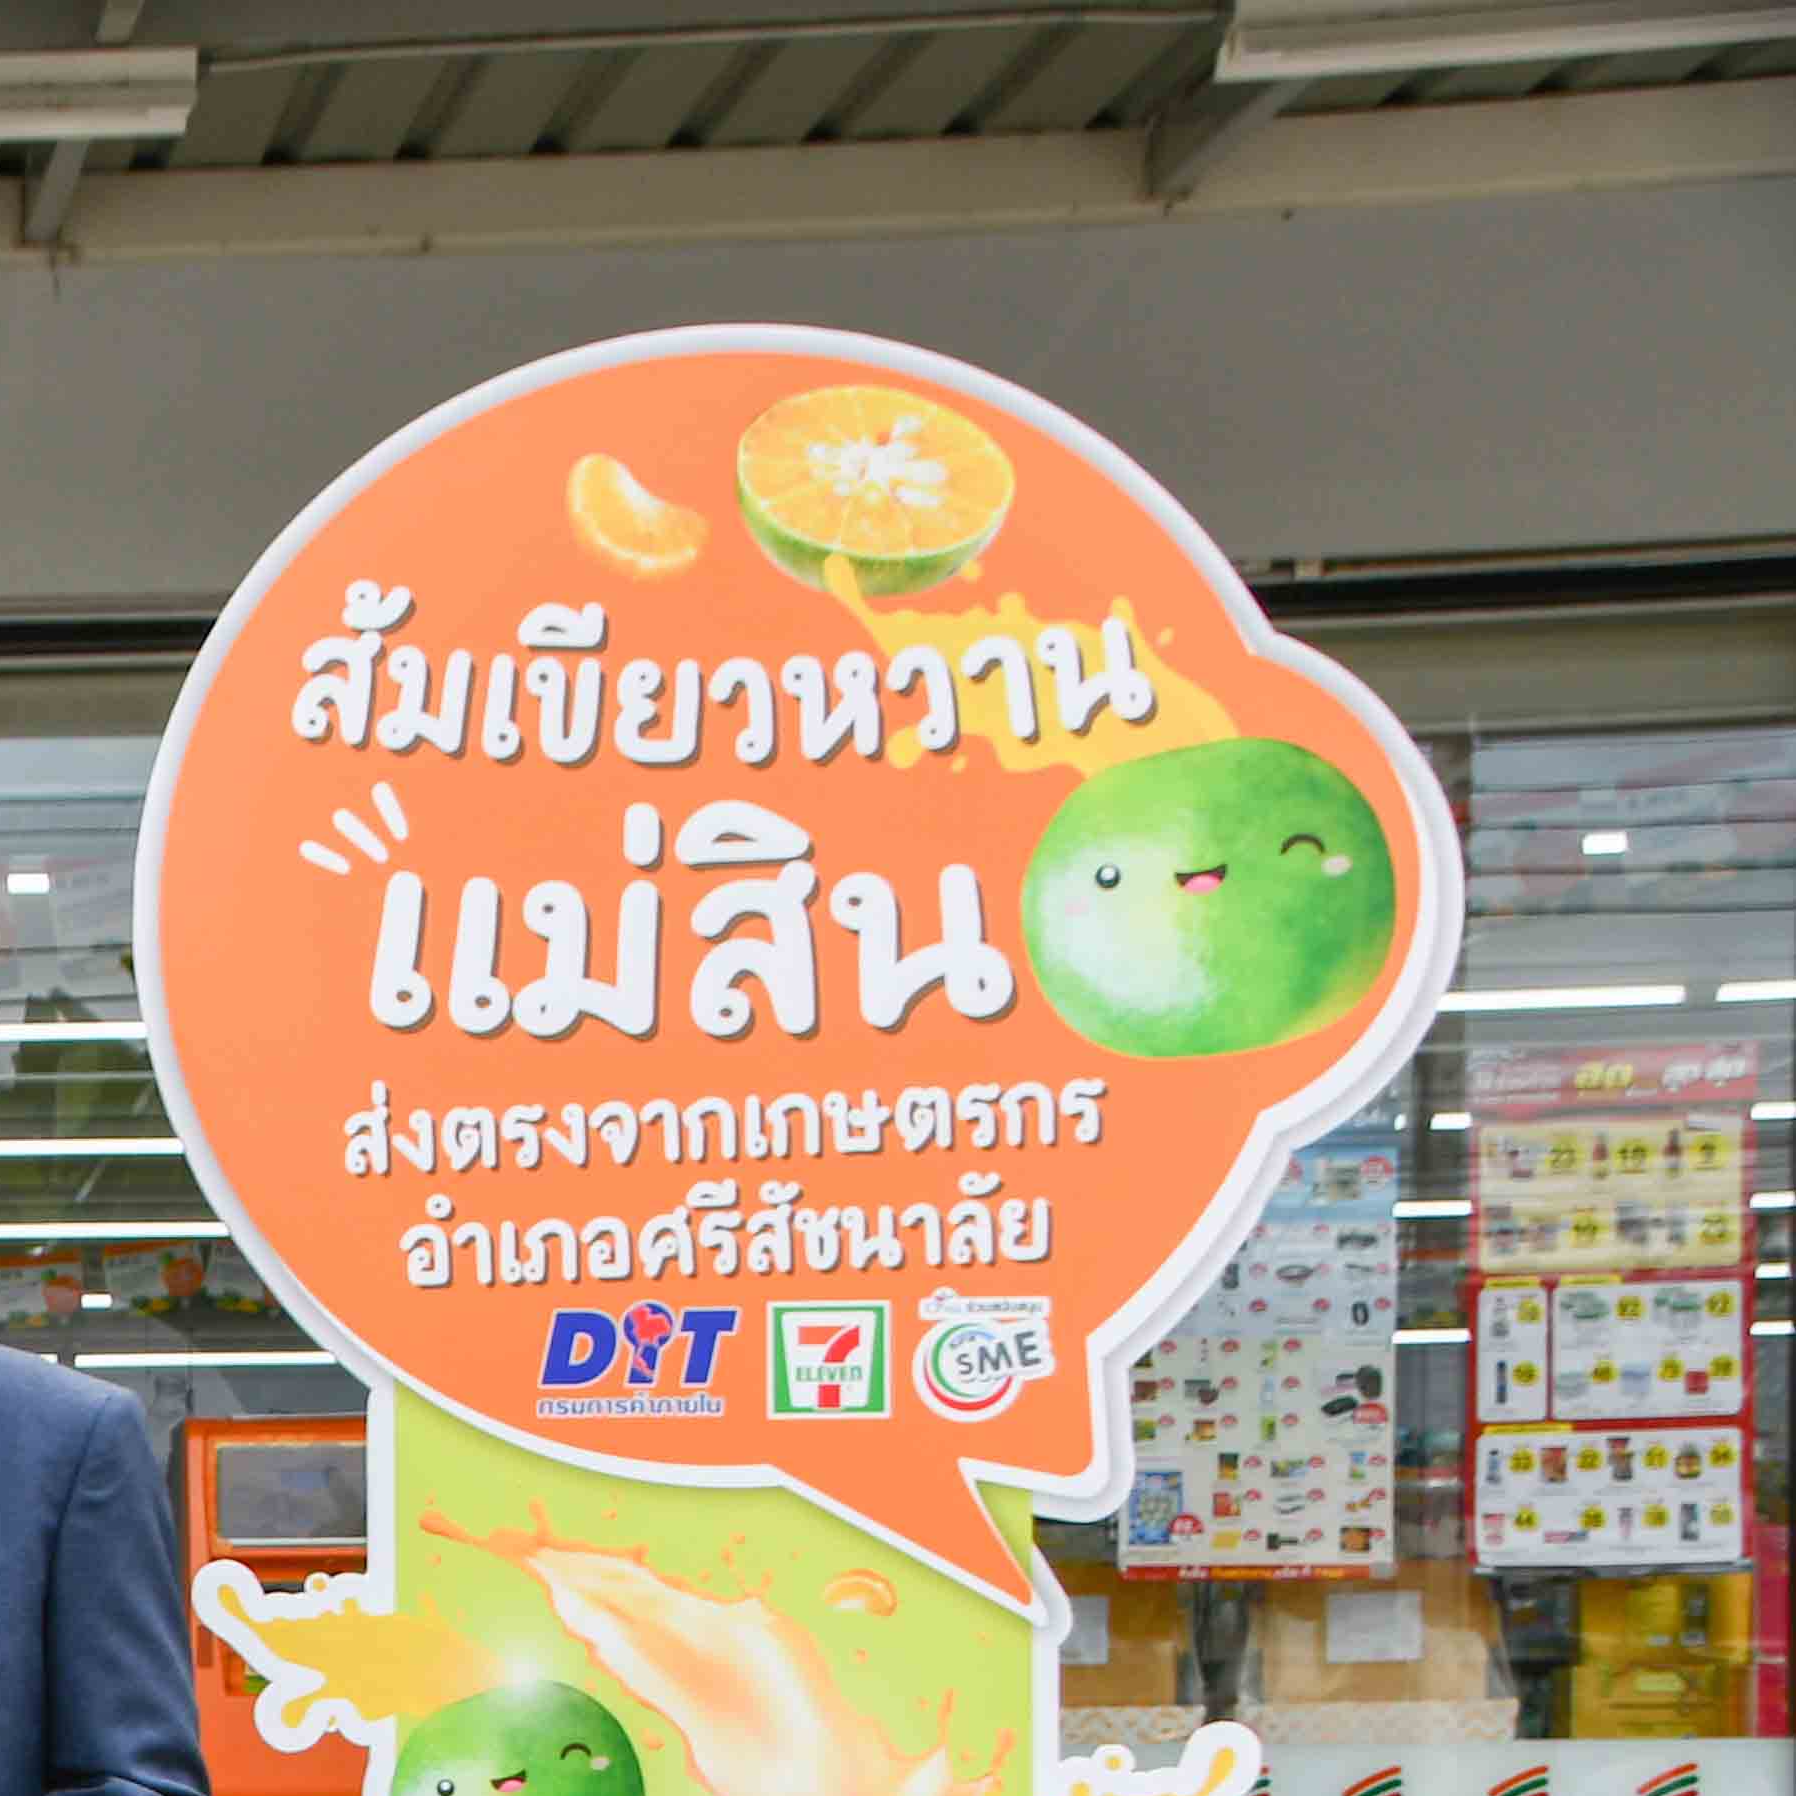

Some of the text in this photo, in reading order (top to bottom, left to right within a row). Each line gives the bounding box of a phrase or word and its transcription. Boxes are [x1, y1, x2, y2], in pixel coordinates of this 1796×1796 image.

[292, 581, 1157, 765] ส้มเขียวหวาน
[368, 802, 1016, 1039] แม่สิน
[344, 1070, 1107, 1177] ส่งตรงจากเกษตรกร
[401, 1172, 1053, 1287] อำเภอศรีสัชนาลัย
[538, 1392, 722, 1416] กรมการค้าภายใน
[955, 1331, 1043, 1376] SME
